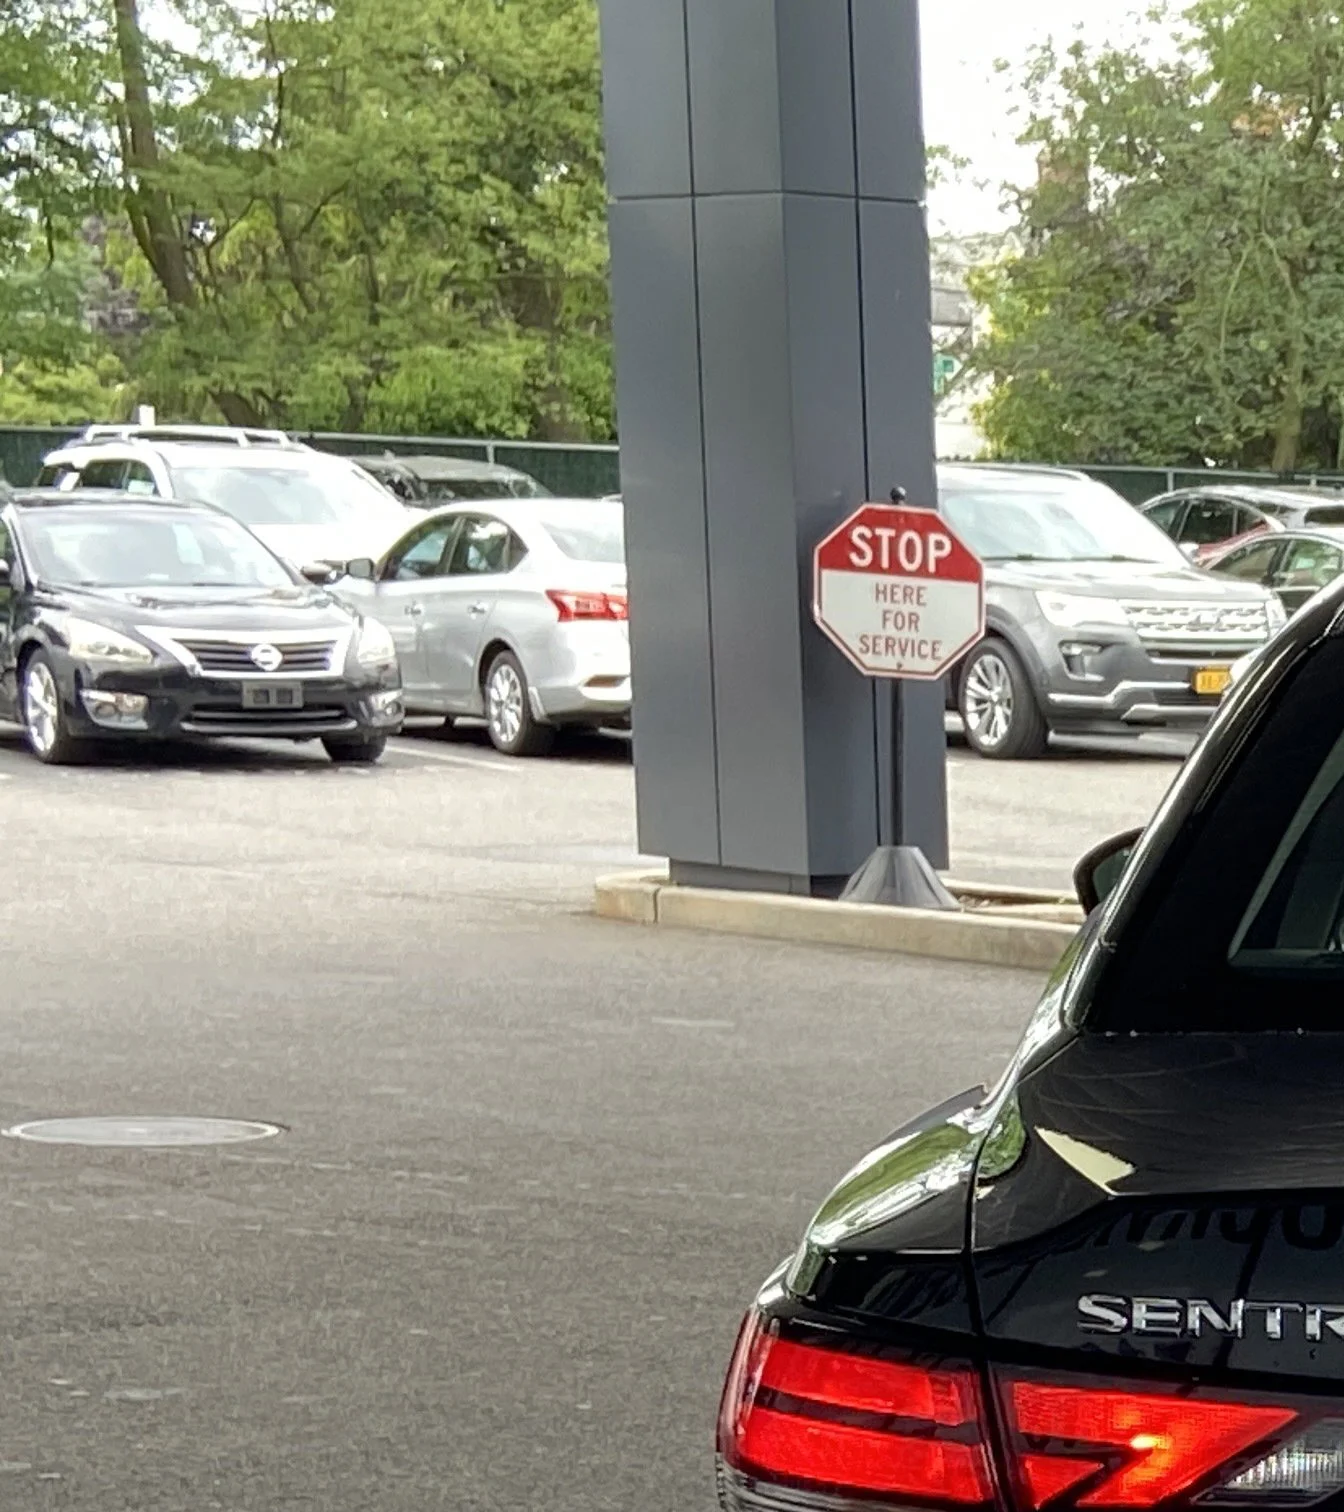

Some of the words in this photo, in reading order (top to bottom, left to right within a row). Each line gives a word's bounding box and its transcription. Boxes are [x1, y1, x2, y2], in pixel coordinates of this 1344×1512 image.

[849, 525, 953, 574] STOP
[874, 582, 928, 607] HERE
[881, 609, 921, 633] FOR
[858, 633, 943, 661] SERVICE
